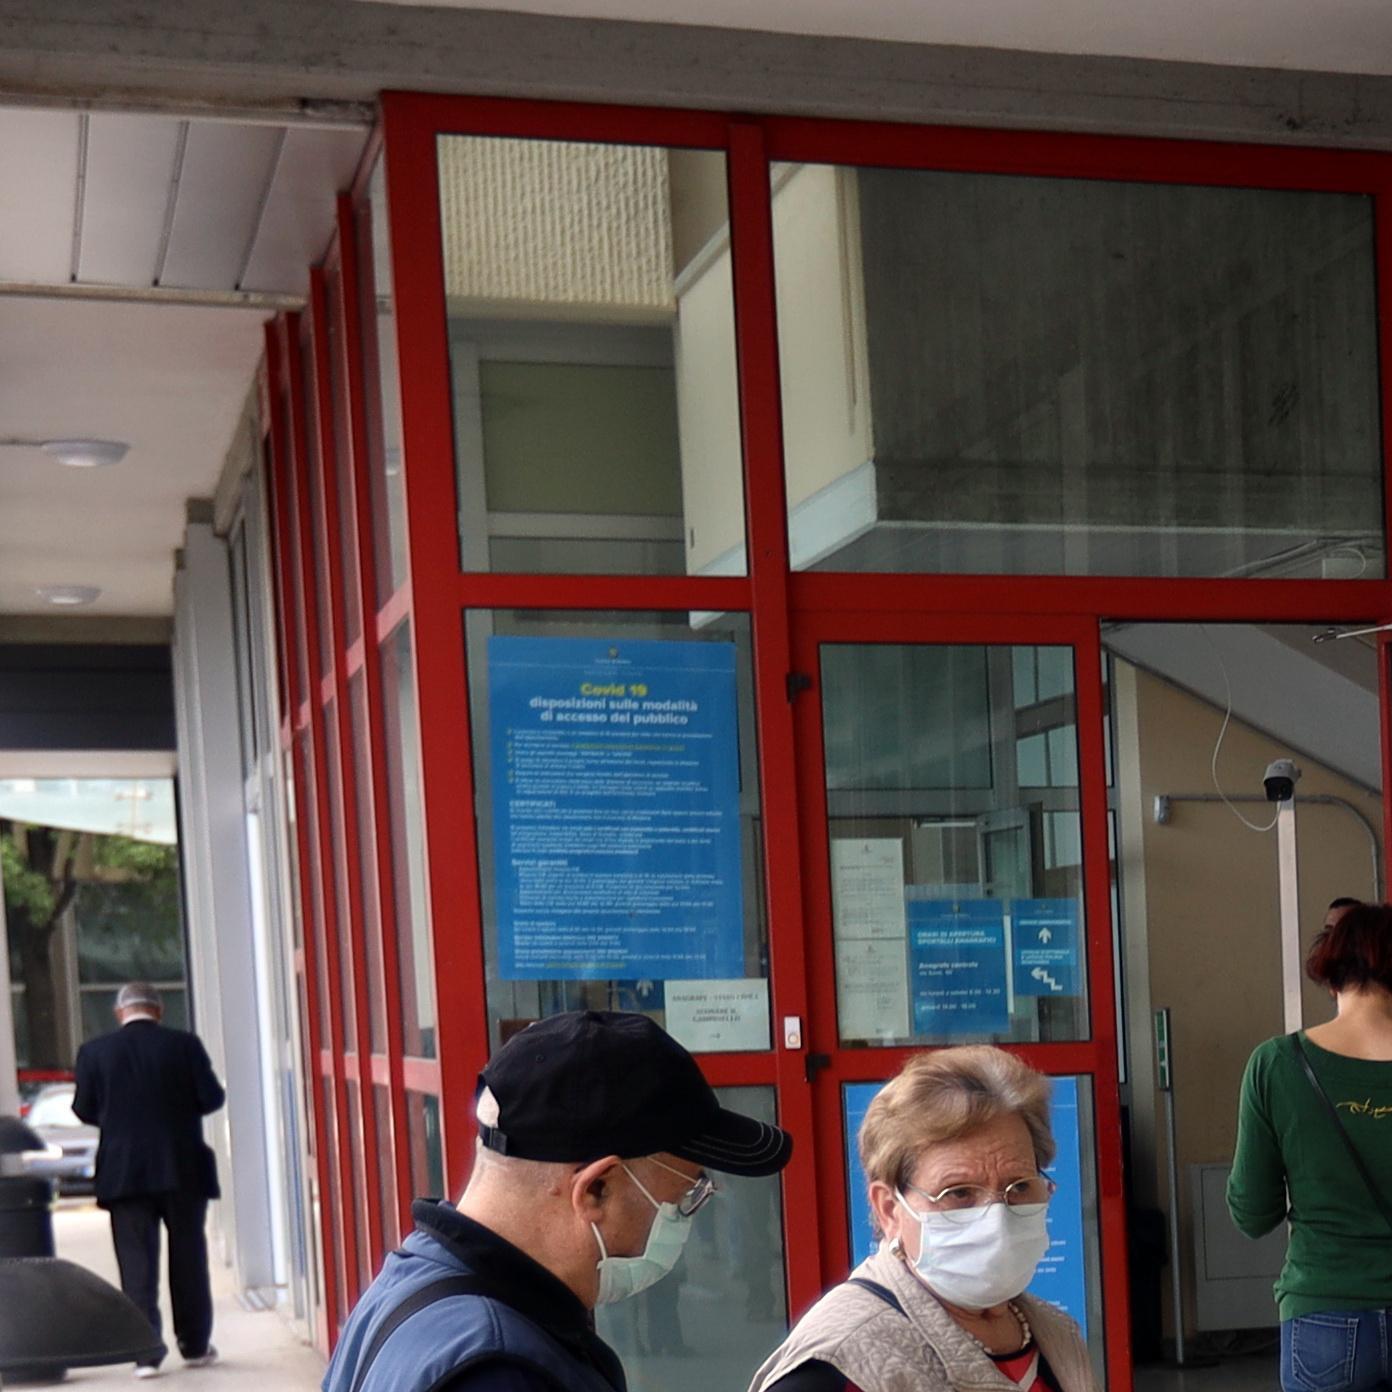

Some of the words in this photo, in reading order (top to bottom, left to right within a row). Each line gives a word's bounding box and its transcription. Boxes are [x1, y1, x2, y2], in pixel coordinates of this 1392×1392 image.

[581, 683, 625, 696] Covid
[630, 683, 648, 697] 19
[529, 696, 606, 712] disposizioni
[609, 699, 639, 711] sulle
[642, 699, 698, 712] modalità
[540, 710, 553, 721] di
[556, 712, 607, 723] accesso
[610, 712, 630, 724] del
[633, 712, 688, 726] pubblico
